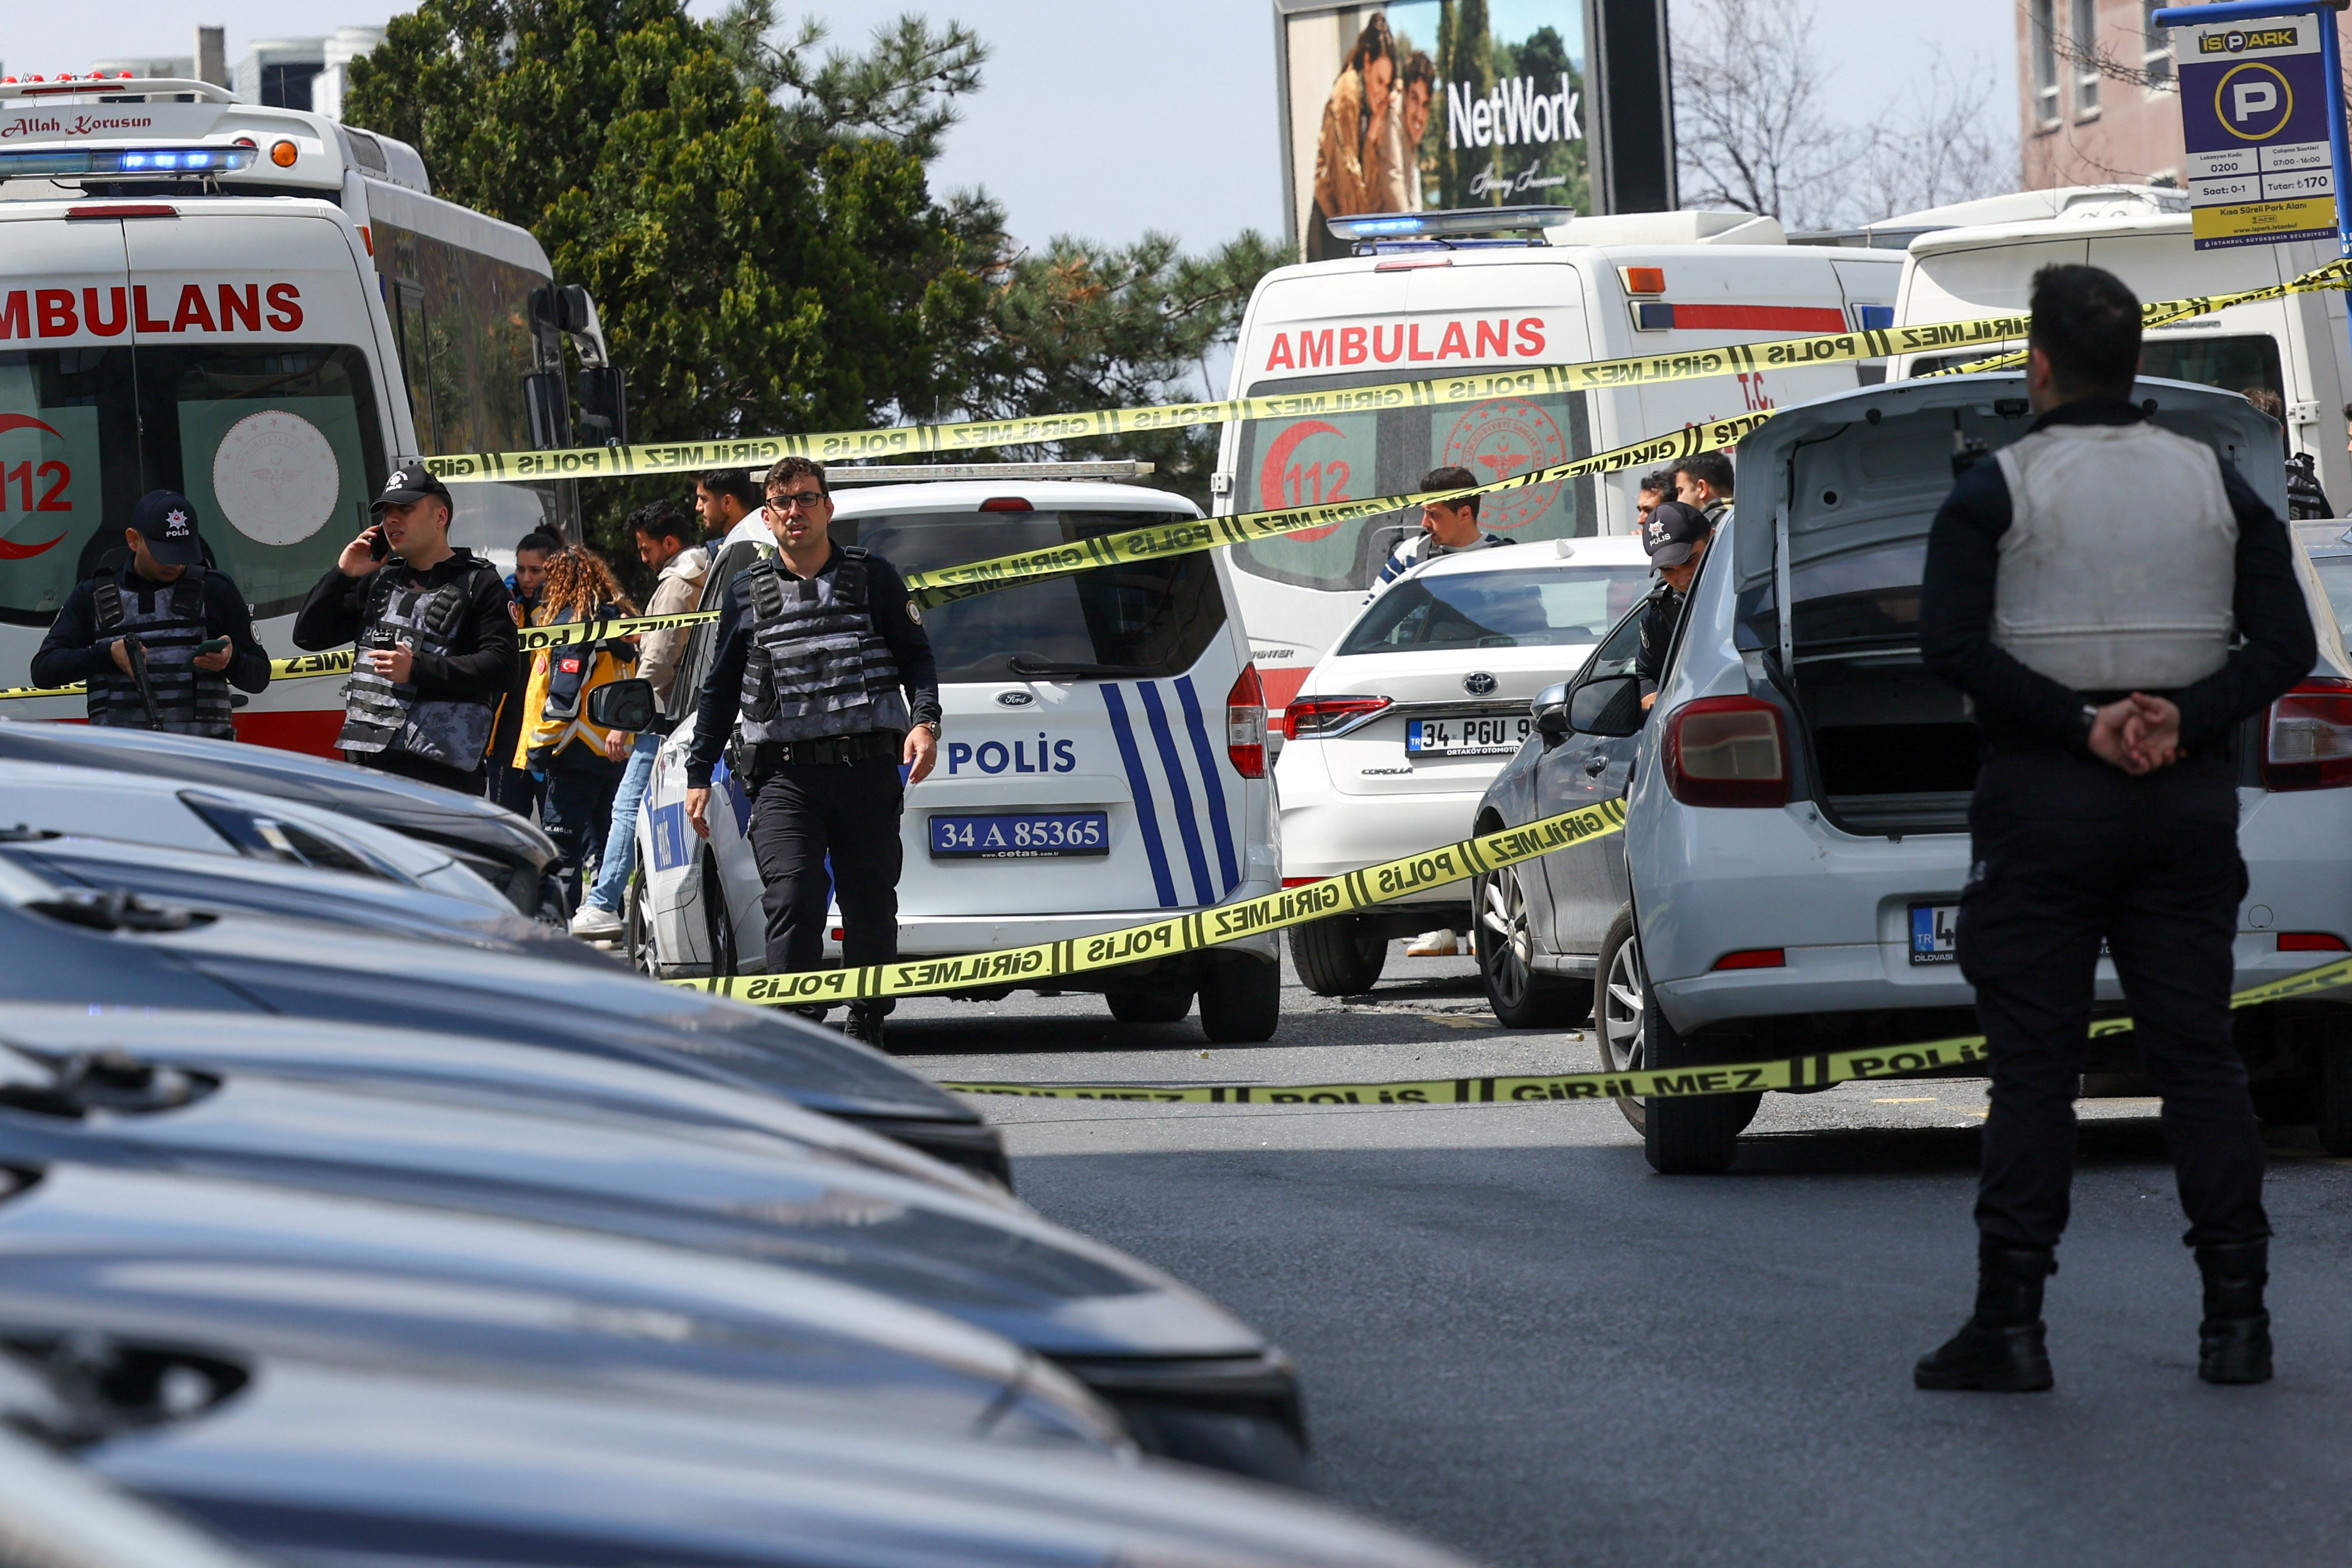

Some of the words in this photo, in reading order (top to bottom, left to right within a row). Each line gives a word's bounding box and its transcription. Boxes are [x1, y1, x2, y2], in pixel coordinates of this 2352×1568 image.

[1448, 73, 1581, 149] NetWork
[1, 117, 60, 137] Allah
[65, 116, 151, 135] Korusun
[2211, 163, 2238, 172] 0200
[2203, 187, 2229, 195] Saat:
[2231, 185, 2246, 193] 0-1
[2240, 206, 2263, 214] Süreli
[1265, 317, 1546, 371] AMBULANS
[1284, 460, 1351, 505] 112
[1252, 649, 1294, 659] RINTER
[1005, 694, 1027, 704] Ford
[1423, 723, 1449, 748] 34
[1463, 720, 1506, 746] PGU
[948, 732, 1076, 774] POLİS
[1447, 748, 1483, 756] ORTAKÖY
[1361, 767, 1414, 775] COROLLA
[941, 823, 975, 847] 34
[983, 823, 1008, 846] A
[1015, 820, 1099, 846] 85365
[1917, 933, 1931, 944] TR
